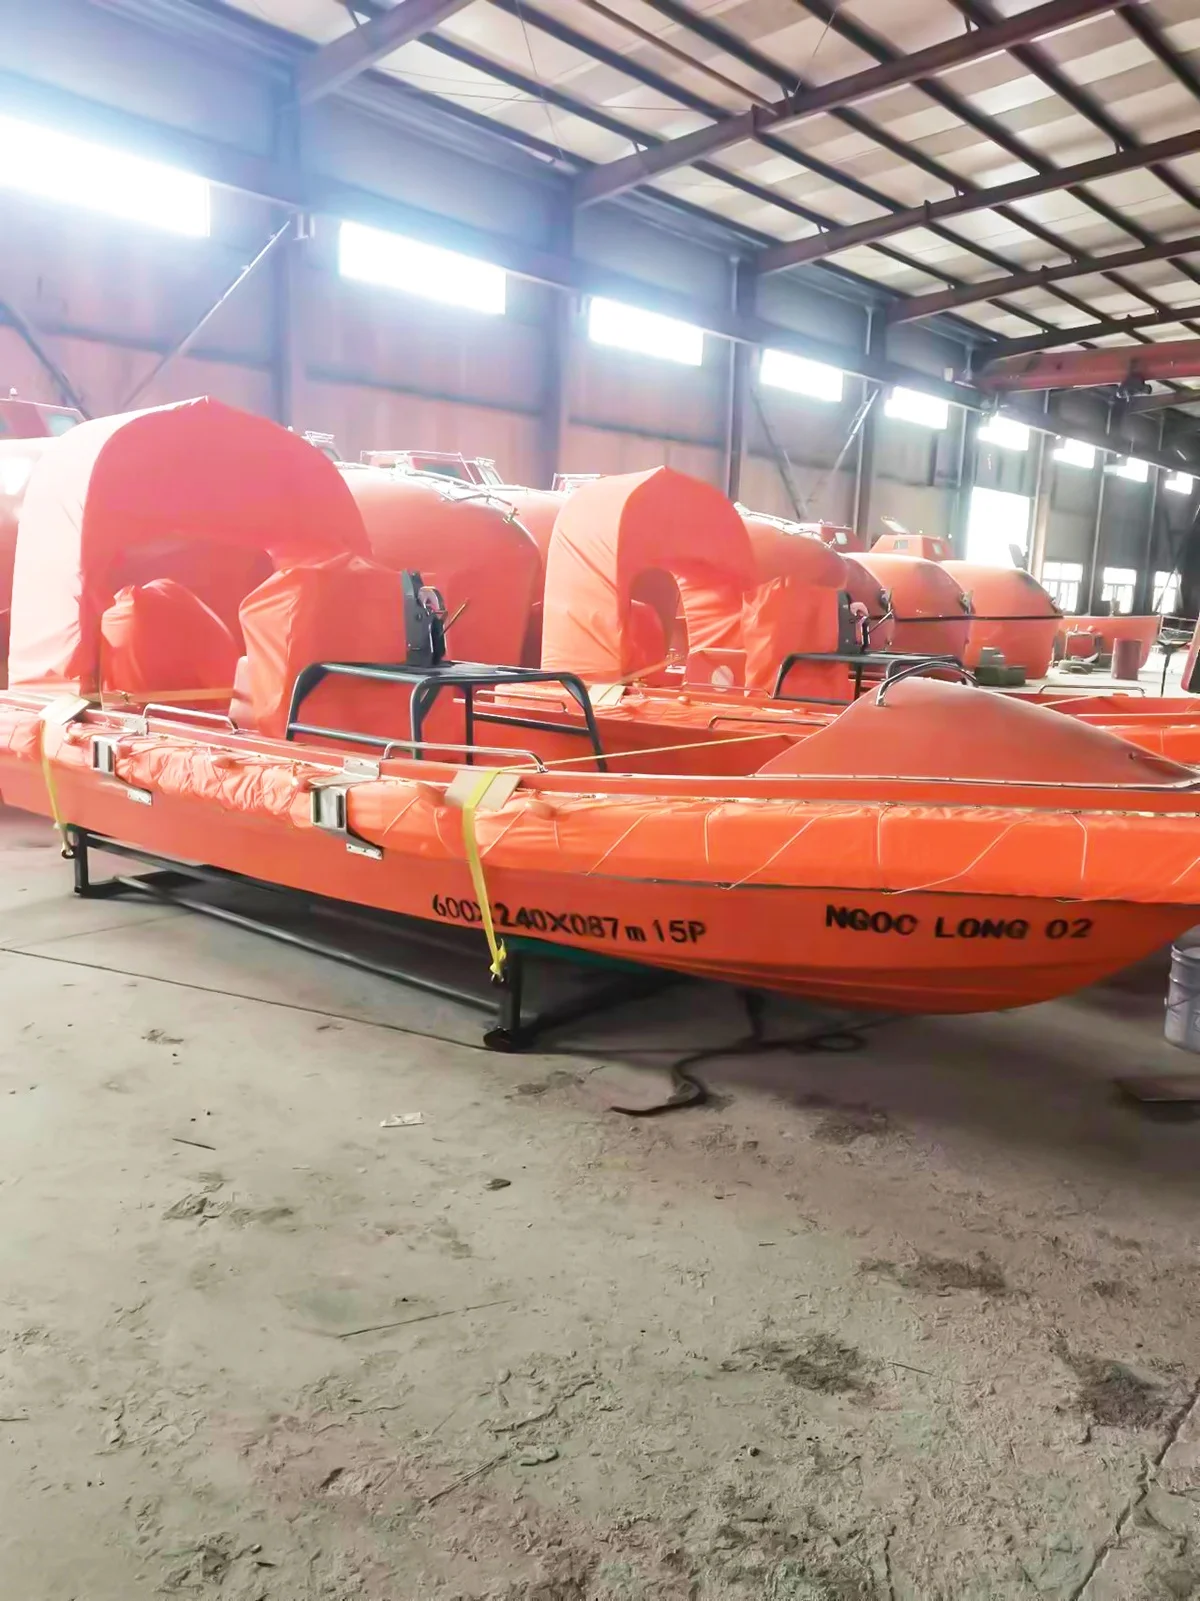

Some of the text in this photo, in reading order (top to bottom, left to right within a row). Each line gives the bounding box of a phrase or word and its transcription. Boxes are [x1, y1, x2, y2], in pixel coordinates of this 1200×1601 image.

[825, 903, 1093, 940] NGOC LONG 02
